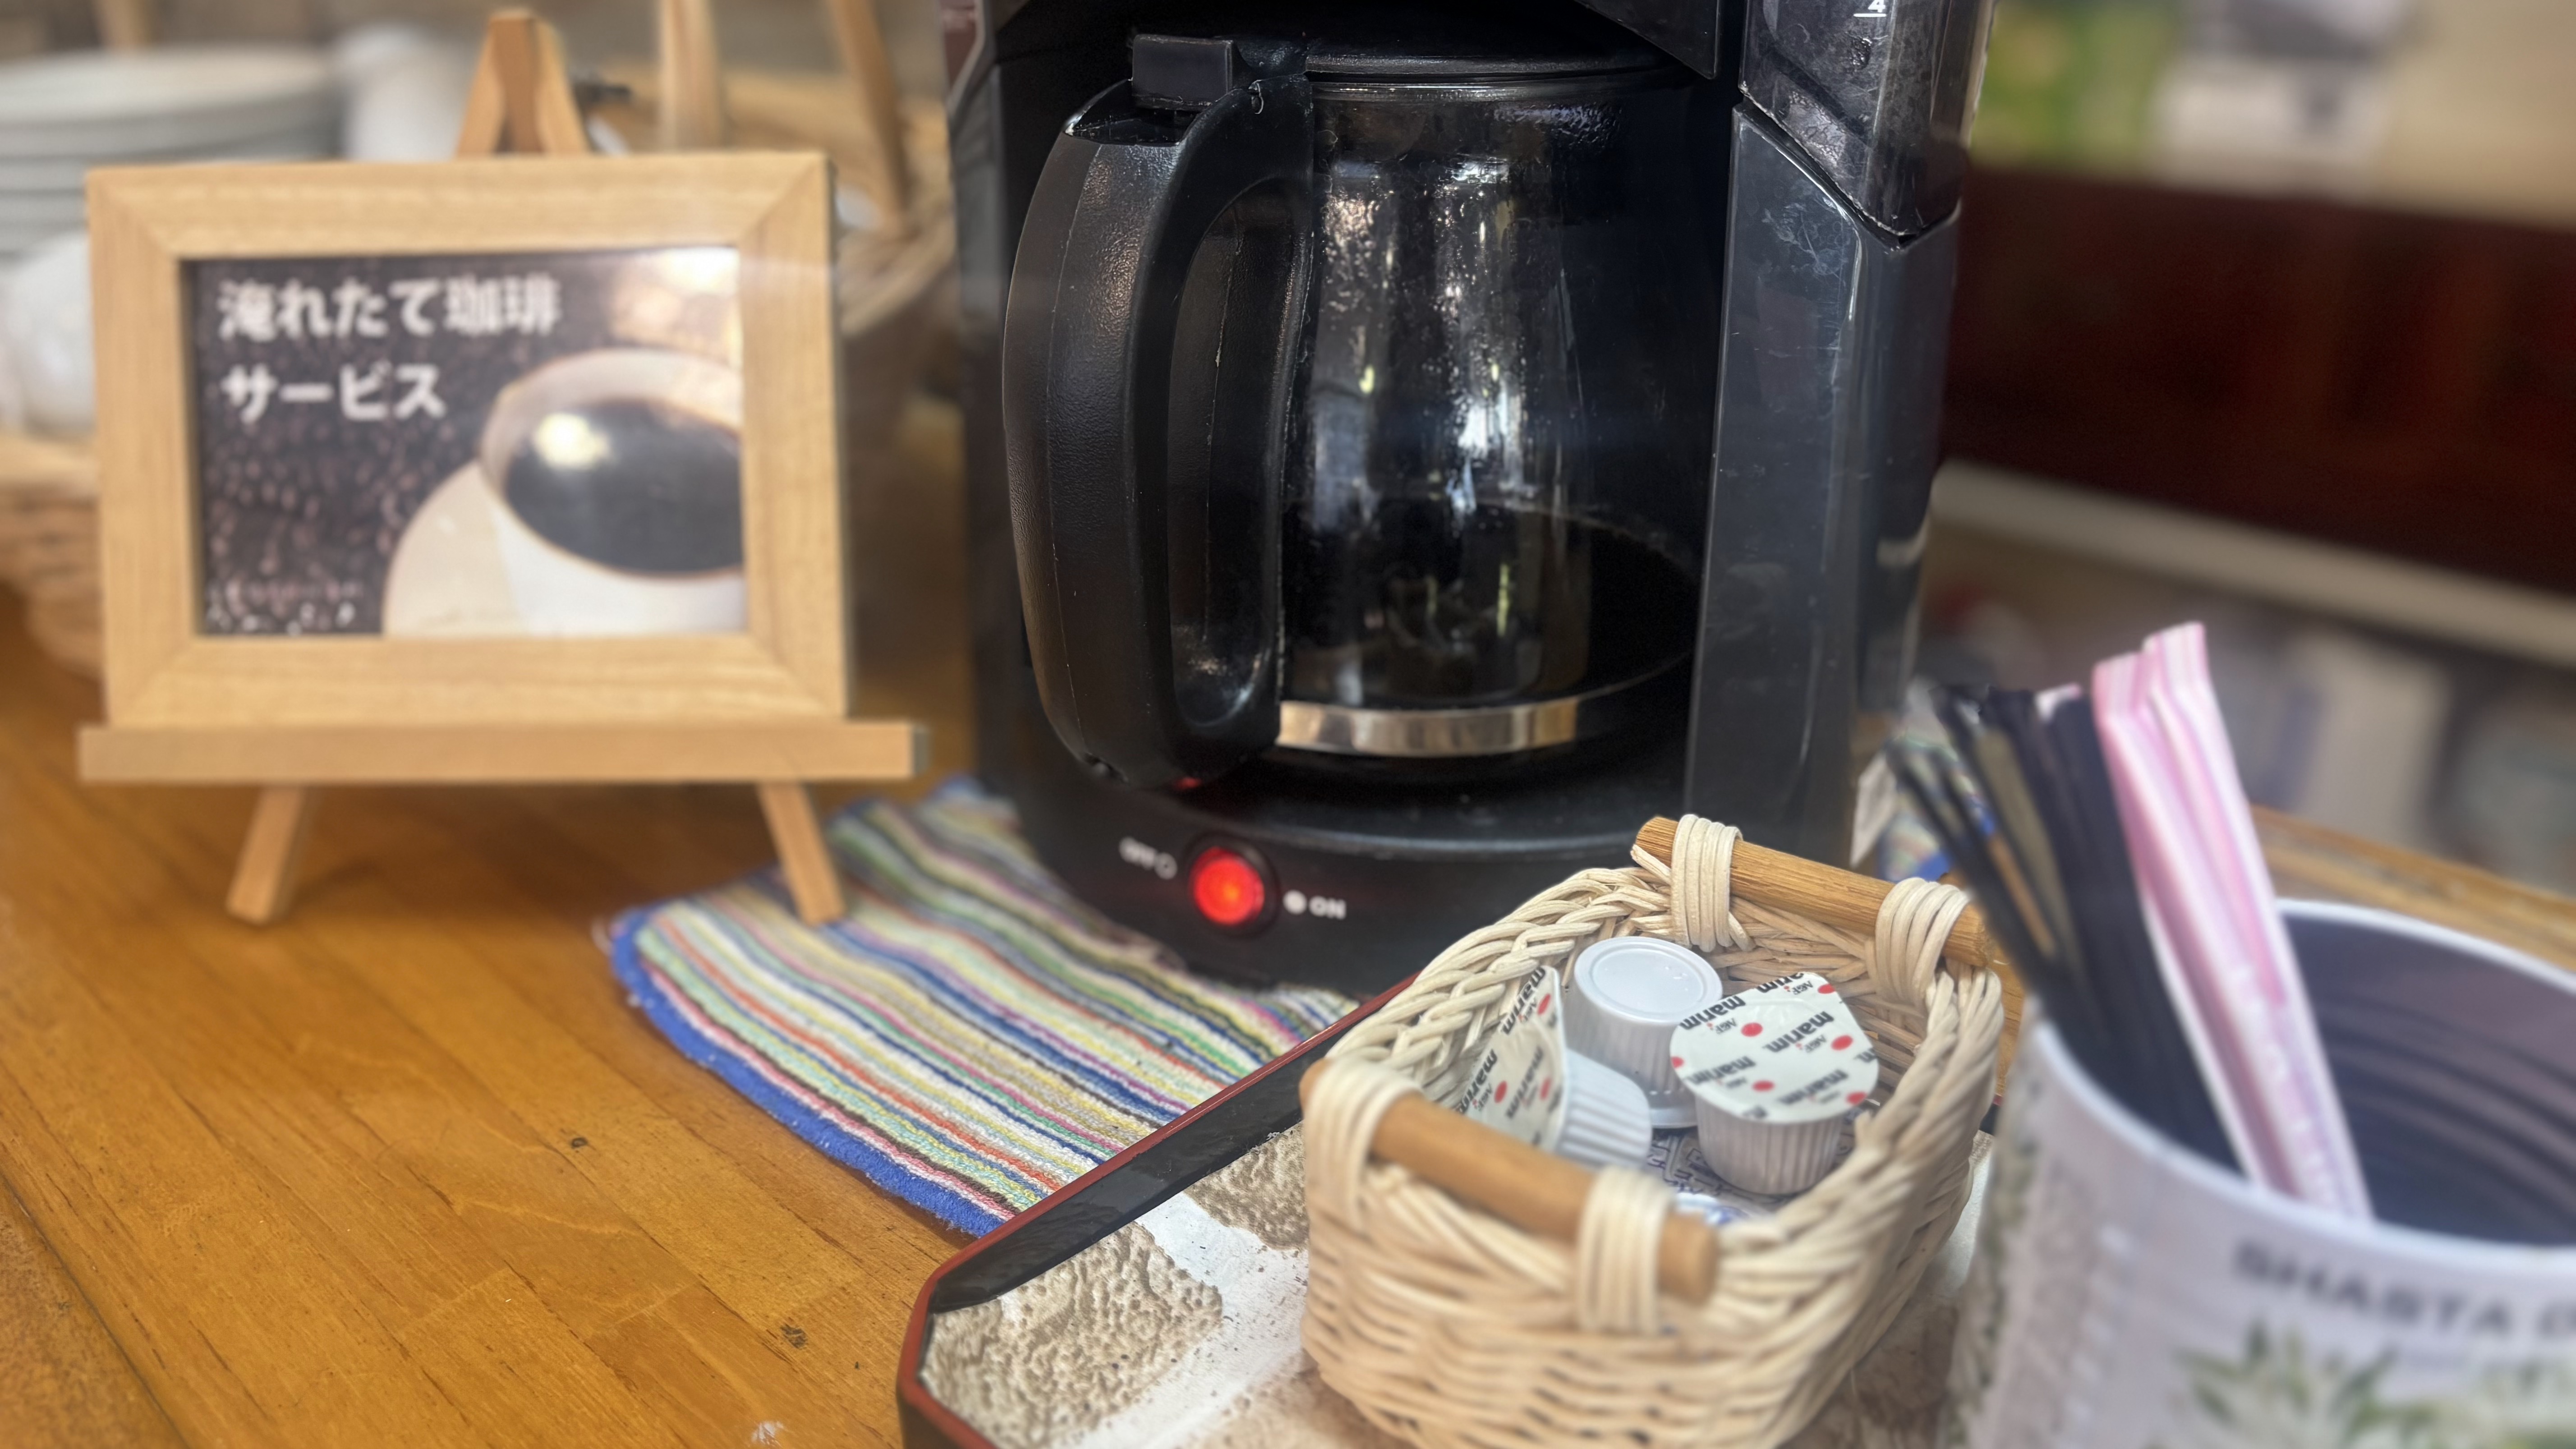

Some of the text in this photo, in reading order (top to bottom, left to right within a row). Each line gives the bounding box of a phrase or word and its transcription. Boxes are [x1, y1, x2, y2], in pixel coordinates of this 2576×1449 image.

[1868, 0, 1886, 13] 4
[217, 273, 561, 341] 淹れたて珈琲
[222, 361, 446, 423] サービス
[1503, 966, 1546, 1035] marim
[1757, 972, 1804, 993] arim
[1679, 995, 1746, 1030] marim
[1765, 1011, 1835, 1053] marim
[1687, 1056, 1756, 1085] marim
